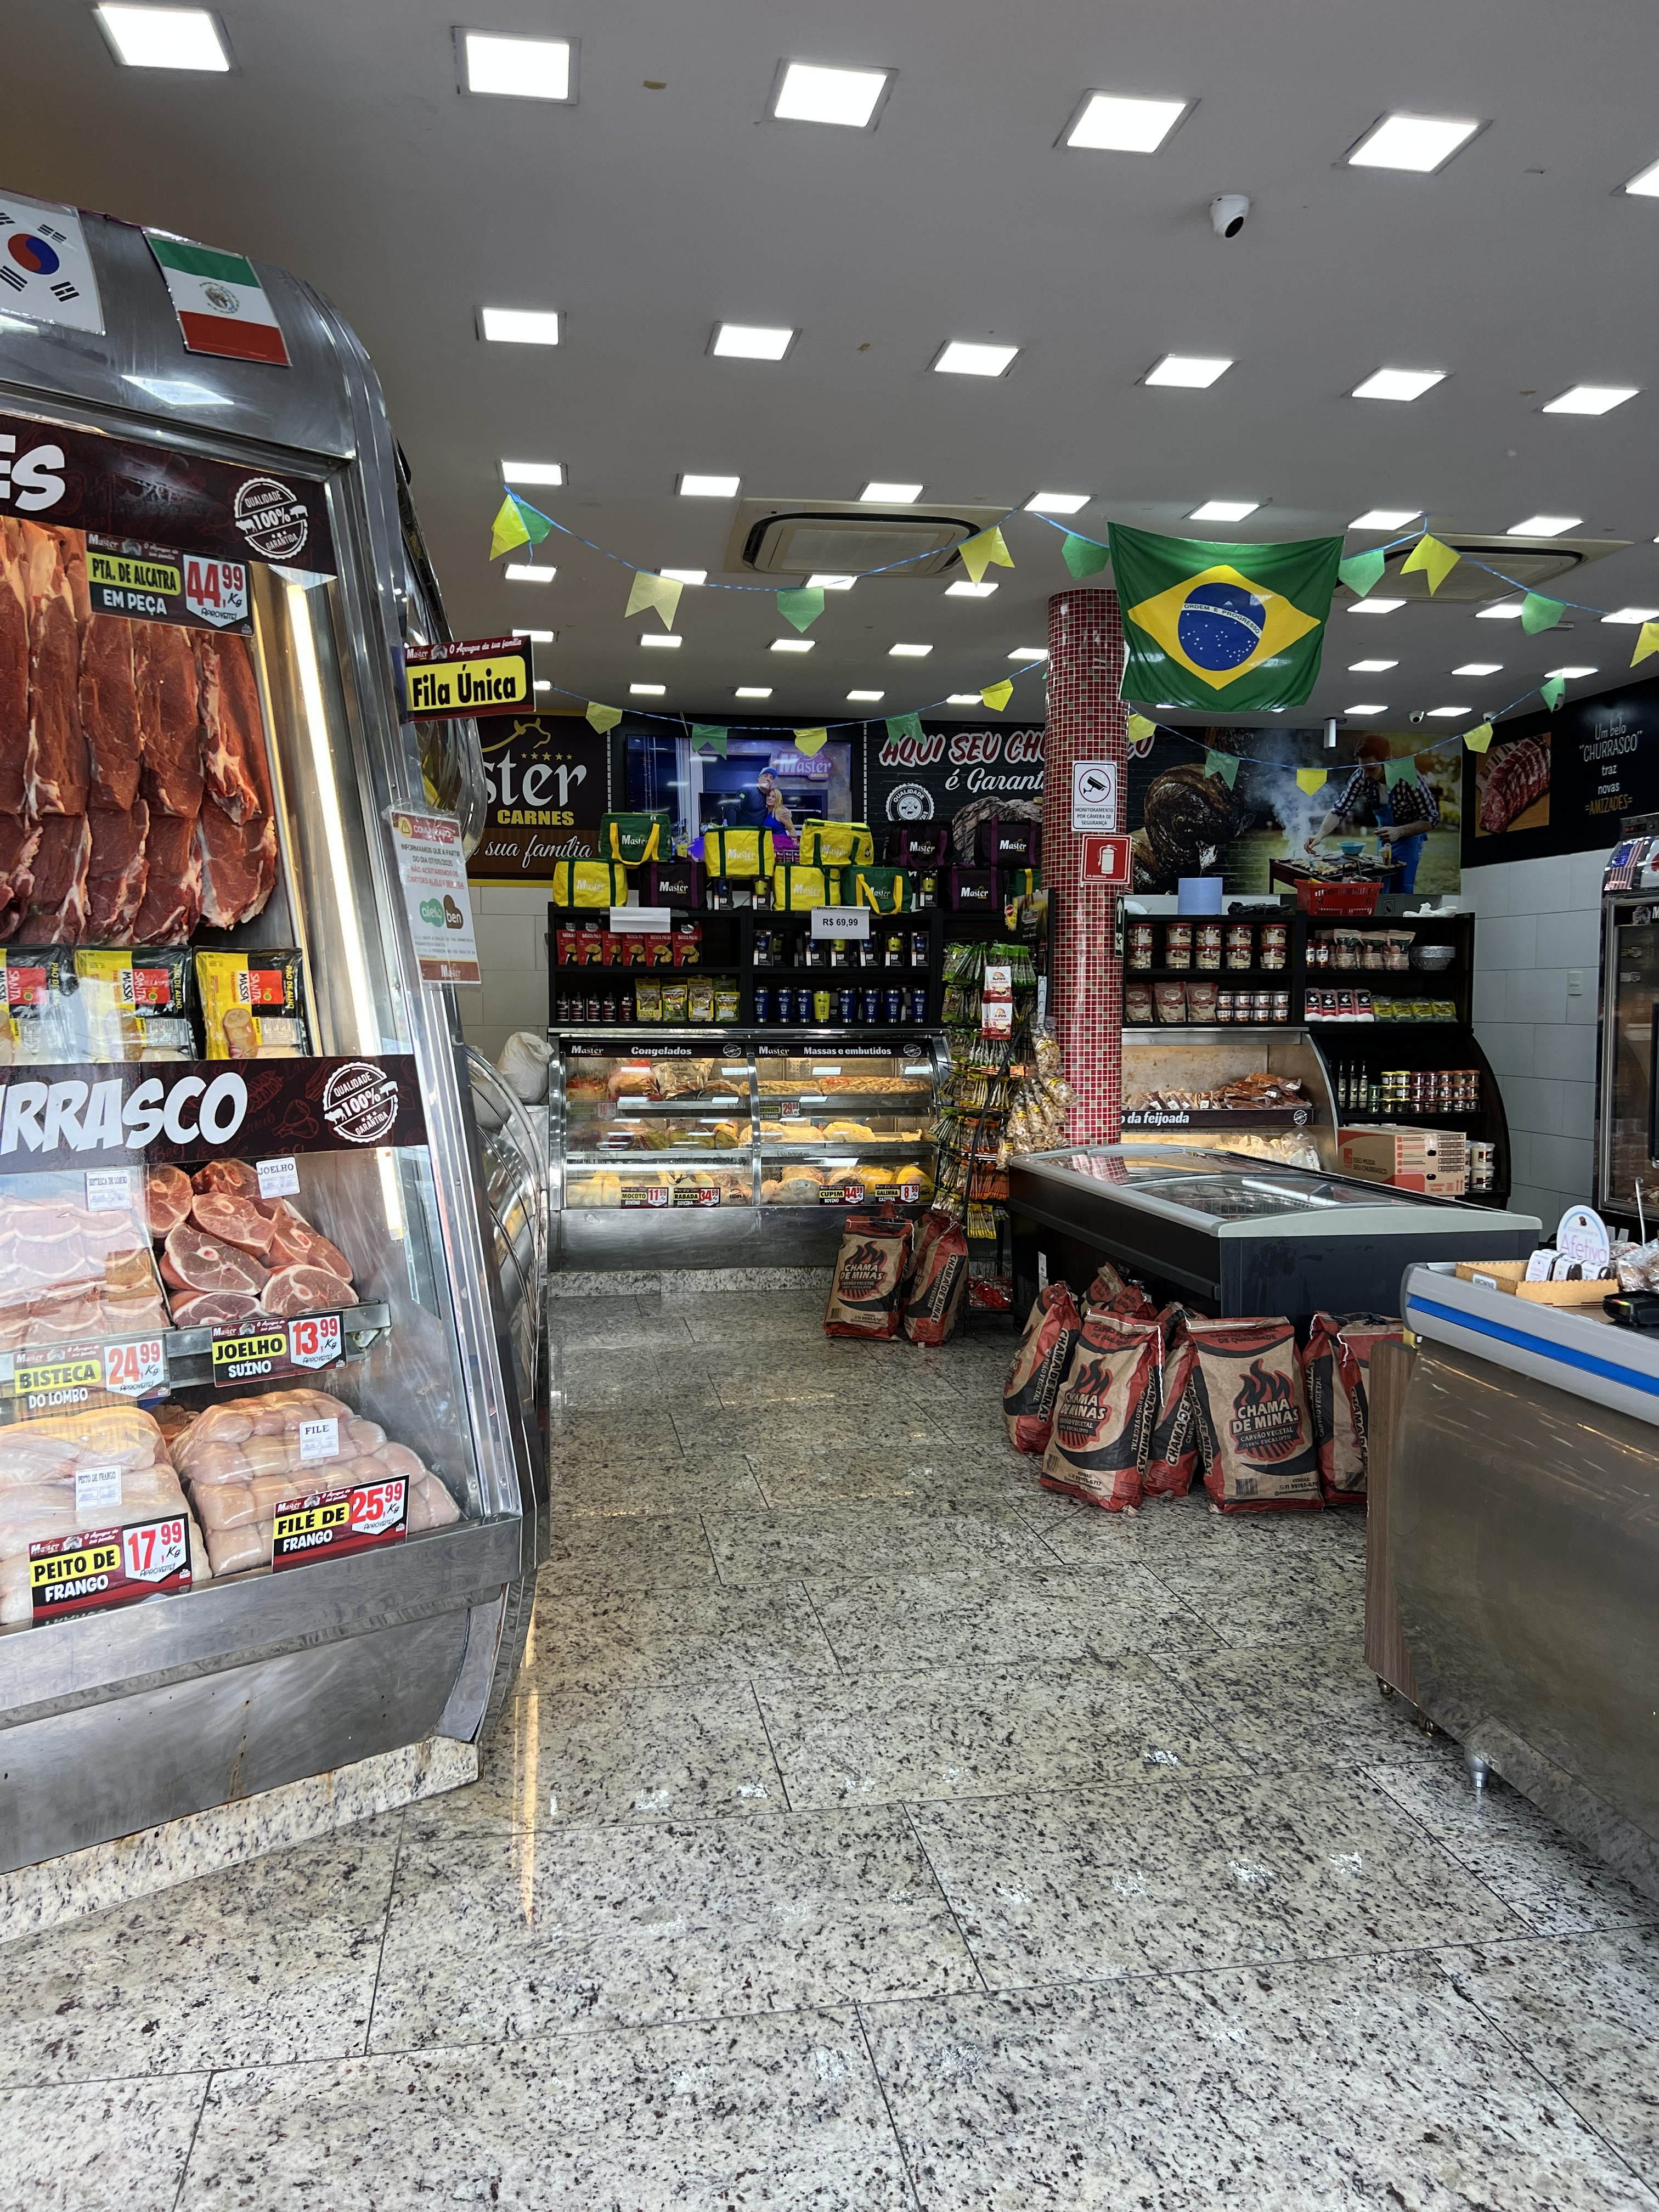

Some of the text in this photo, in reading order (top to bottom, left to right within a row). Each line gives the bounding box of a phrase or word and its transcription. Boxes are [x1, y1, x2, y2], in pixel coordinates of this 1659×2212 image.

[245, 490, 283, 508] QUALIDADE
[253, 507, 291, 530] 100%
[265, 533, 298, 551] GARANTIDA
[92, 558, 177, 591] PTA. DE ALCATRA
[103, 589, 167, 616] EM PEÇA
[228, 593, 242, 607] Kg
[1222, 610, 1260, 635] PROGRESSO
[413, 664, 516, 707] Fila Única
[1595, 716, 1627, 740] Um belo
[880, 732, 1001, 766] AQUI SEU
[779, 754, 832, 773] Master
[1601, 765, 1617, 776] traz
[945, 769, 960, 790] é
[1598, 783, 1620, 794] novas
[893, 789, 926, 803] QUALIDADE
[497, 810, 574, 825] CARNES
[401, 843, 432, 854] INFORMAMOS
[485, 841, 520, 856] sua
[910, 842, 935, 853] Master
[1000, 840, 1026, 851] Master
[728, 849, 755, 861] Master
[576, 880, 606, 892] Master
[659, 881, 689, 893] Master
[794, 884, 822, 896] Master
[961, 887, 989, 898] Master
[445, 909, 462, 924] ben
[836, 919, 859, 927] 69,99
[8, 970, 21, 1001] SANTA
[122, 972, 133, 1001] MASSA
[134, 971, 148, 1001] SANTA
[239, 973, 249, 1001] MASSA
[250, 973, 262, 1004] SANTA
[173, 981, 183, 1009] DE ALHO
[286, 981, 295, 1009] DE ALHO
[571, 1045, 692, 1056] Master Congelados
[759, 1046, 789, 1056] Master
[804, 1047, 837, 1055] Massas
[845, 1047, 891, 1055] embutidos
[334, 1072, 373, 1097] QUALIDADE
[342, 1087, 381, 1117] 100%
[354, 1111, 388, 1136] GARANTIDA
[1127, 1111, 1189, 1126] da feijoada
[258, 1164, 294, 1175] JOELHO
[1362, 1165, 1387, 1175] CHURRASCO
[1560, 1234, 1607, 1263] Afetiva
[840, 1271, 884, 1280] DE MINAS
[844, 1263, 878, 1272] CHAMA
[941, 1254, 957, 1284] CHAMA
[938, 1285, 949, 1298] DE
[930, 1297, 945, 1325] MINAS
[213, 1327, 236, 1337] Master
[1231, 1334, 1277, 1344] QUALIDADE
[216, 1338, 283, 1361] JOELHO
[325, 1339, 337, 1349] Kg
[20, 1364, 96, 1389] BISTECA
[145, 1364, 159, 1376] Kg
[228, 1360, 272, 1378] SUÍNO
[1039, 1328, 1068, 1423] CHAMA DE MINAS
[1032, 1374, 1046, 1402] VEGETAL
[29, 1387, 88, 1408] DO LOMBO
[1066, 1392, 1098, 1407] CHAMA
[1060, 1403, 1106, 1420] DE MINAS
[1237, 1398, 1290, 1419] CHAMA
[1351, 1387, 1364, 1436] CHAMA
[305, 1424, 329, 1435] FILE
[1071, 1420, 1093, 1429] VEGETAL
[1232, 1408, 1299, 1434] DE MINAS
[1131, 1420, 1141, 1452] VEGETAL
[1240, 1426, 1294, 1442] CARVÃO VEGETAL
[1261, 1434, 1291, 1445] EUCALIPTO
[1137, 1414, 1151, 1474] DE MINAS
[1166, 1421, 1186, 1466] CHAMA
[78, 1475, 91, 1483] PEITO
[278, 1501, 302, 1513] Master
[387, 1503, 400, 1514] Kg
[278, 1506, 345, 1536] FILÉ DE
[283, 1529, 333, 1553] FRANGO
[166, 1545, 182, 1558] Kg
[35, 1549, 116, 1582] PEITO DE
[45, 1574, 109, 1603] FRANGO
